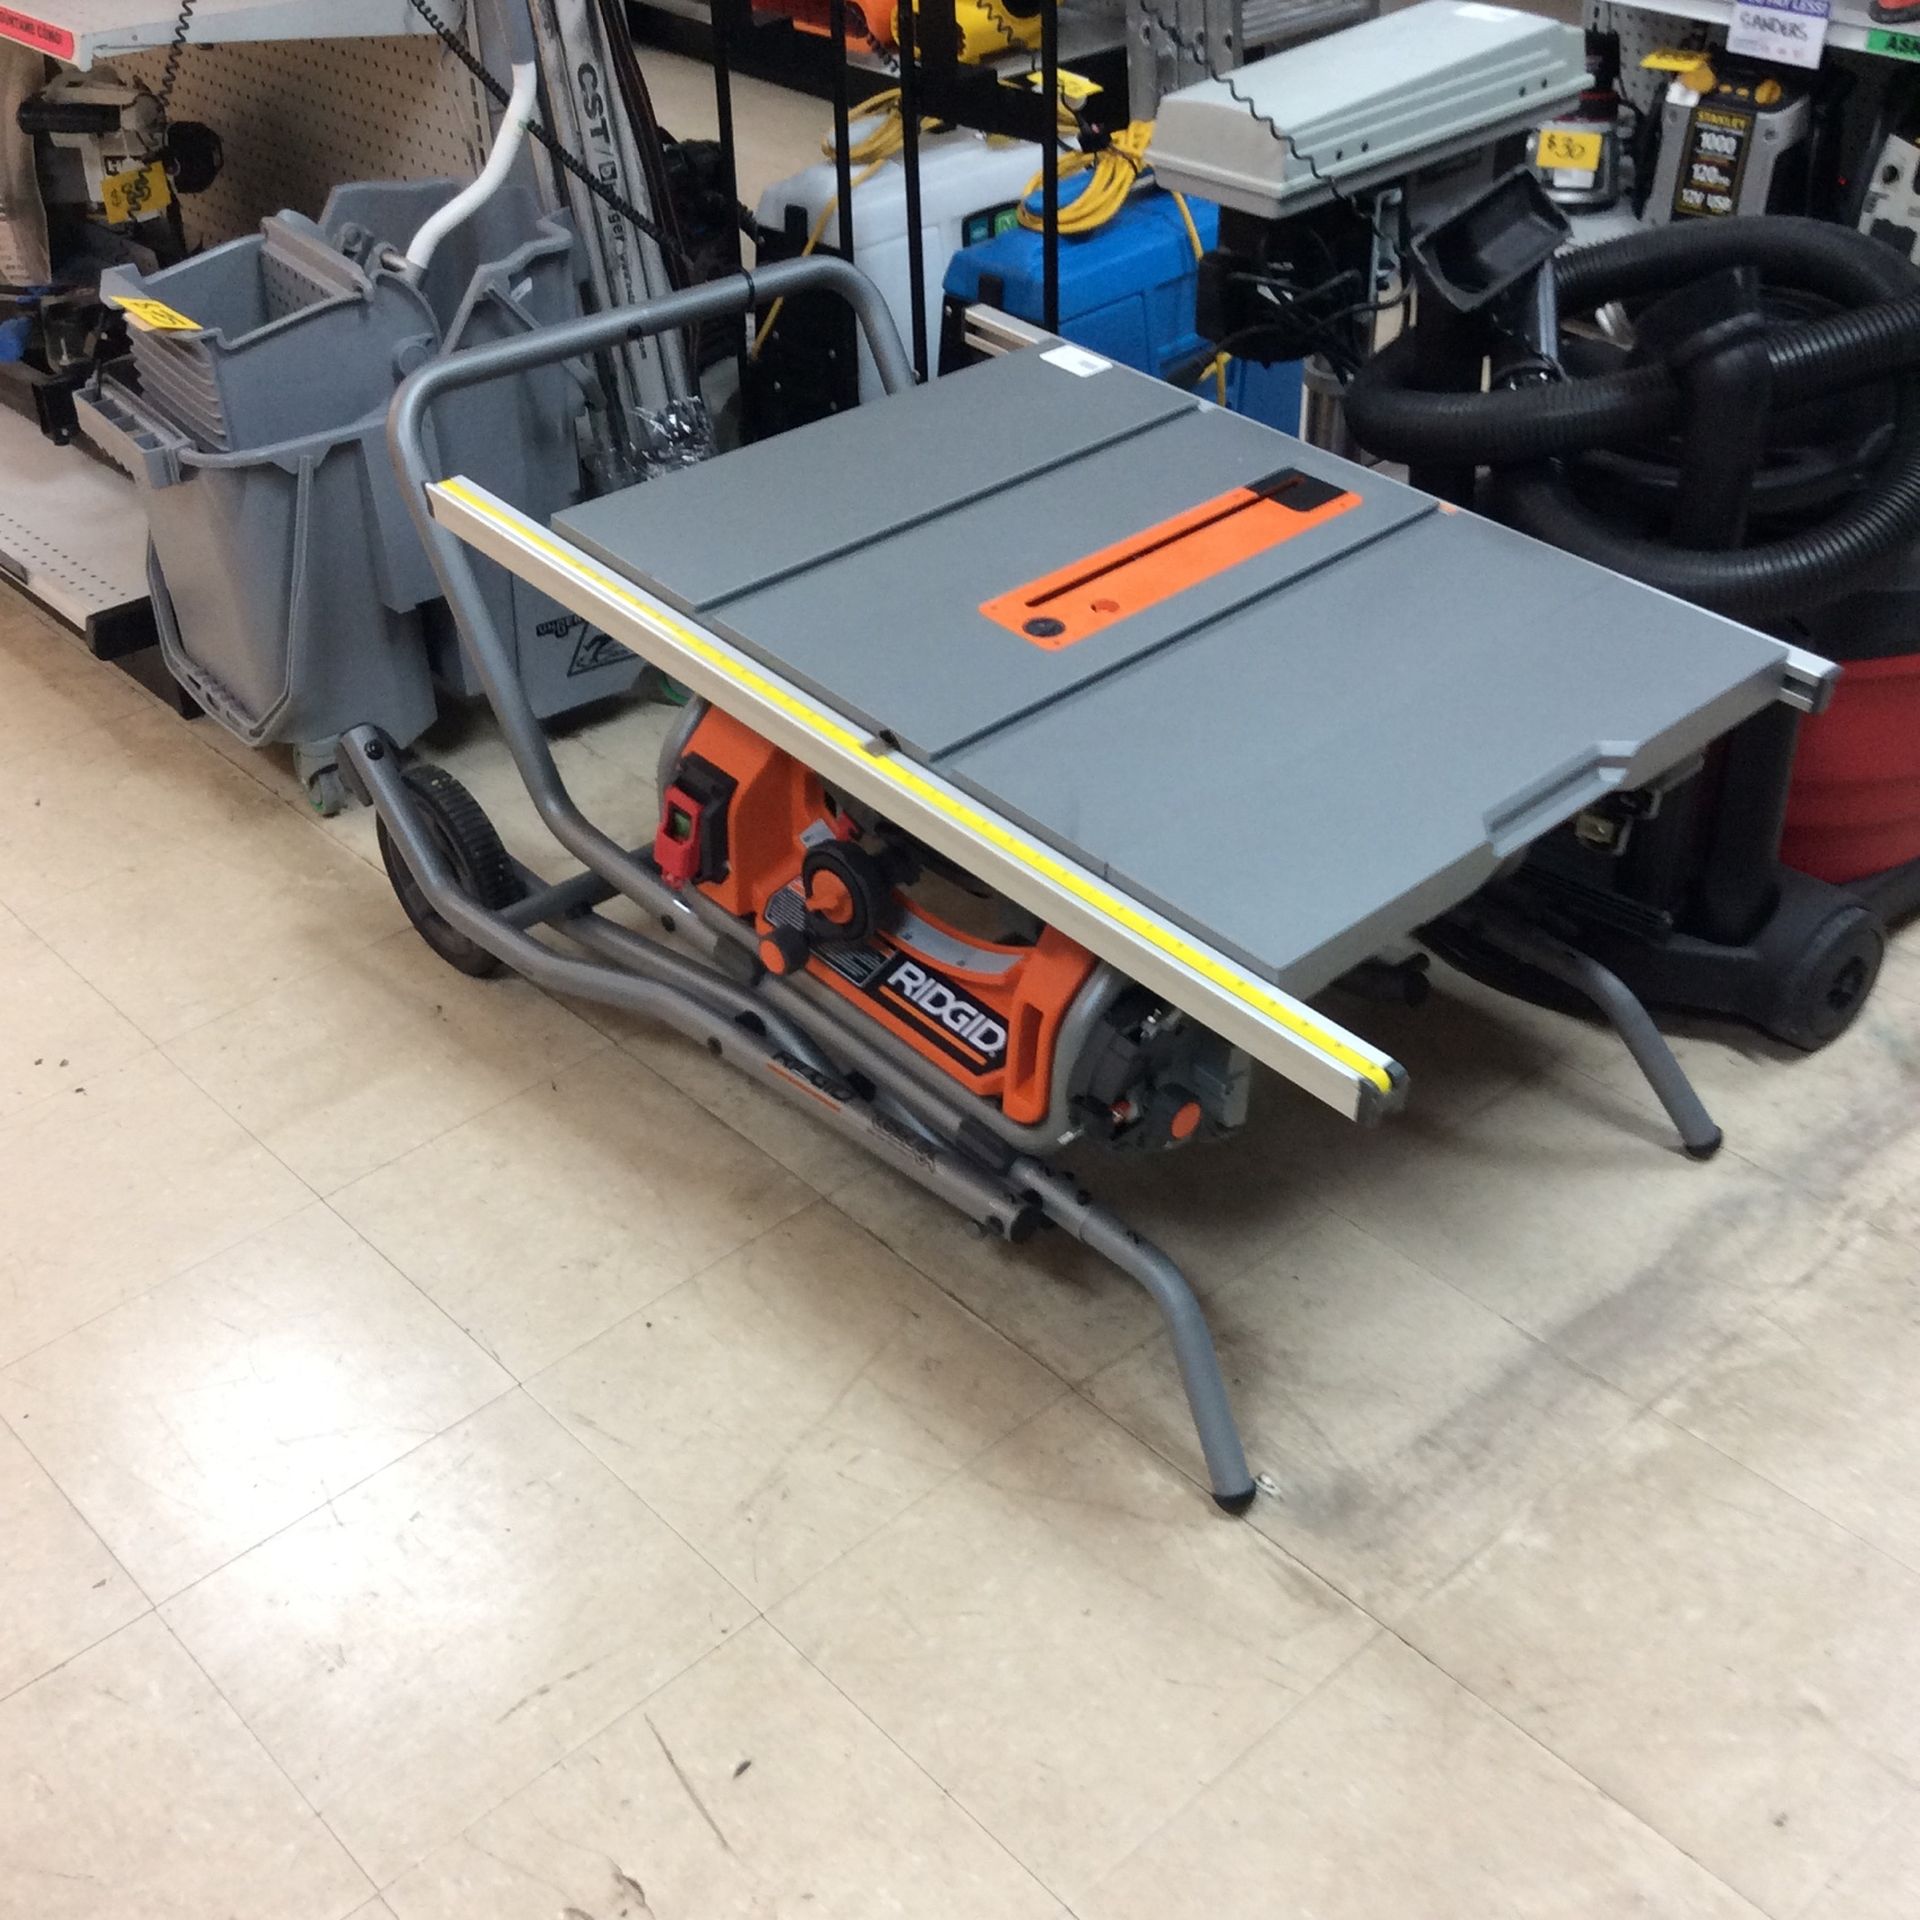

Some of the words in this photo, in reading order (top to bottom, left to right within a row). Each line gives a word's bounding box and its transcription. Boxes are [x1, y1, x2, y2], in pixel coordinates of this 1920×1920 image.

[1697, 110, 1746, 129] STANLEY
[1701, 132, 1737, 155] 1000
[887, 961, 1007, 1052] RIDGID
